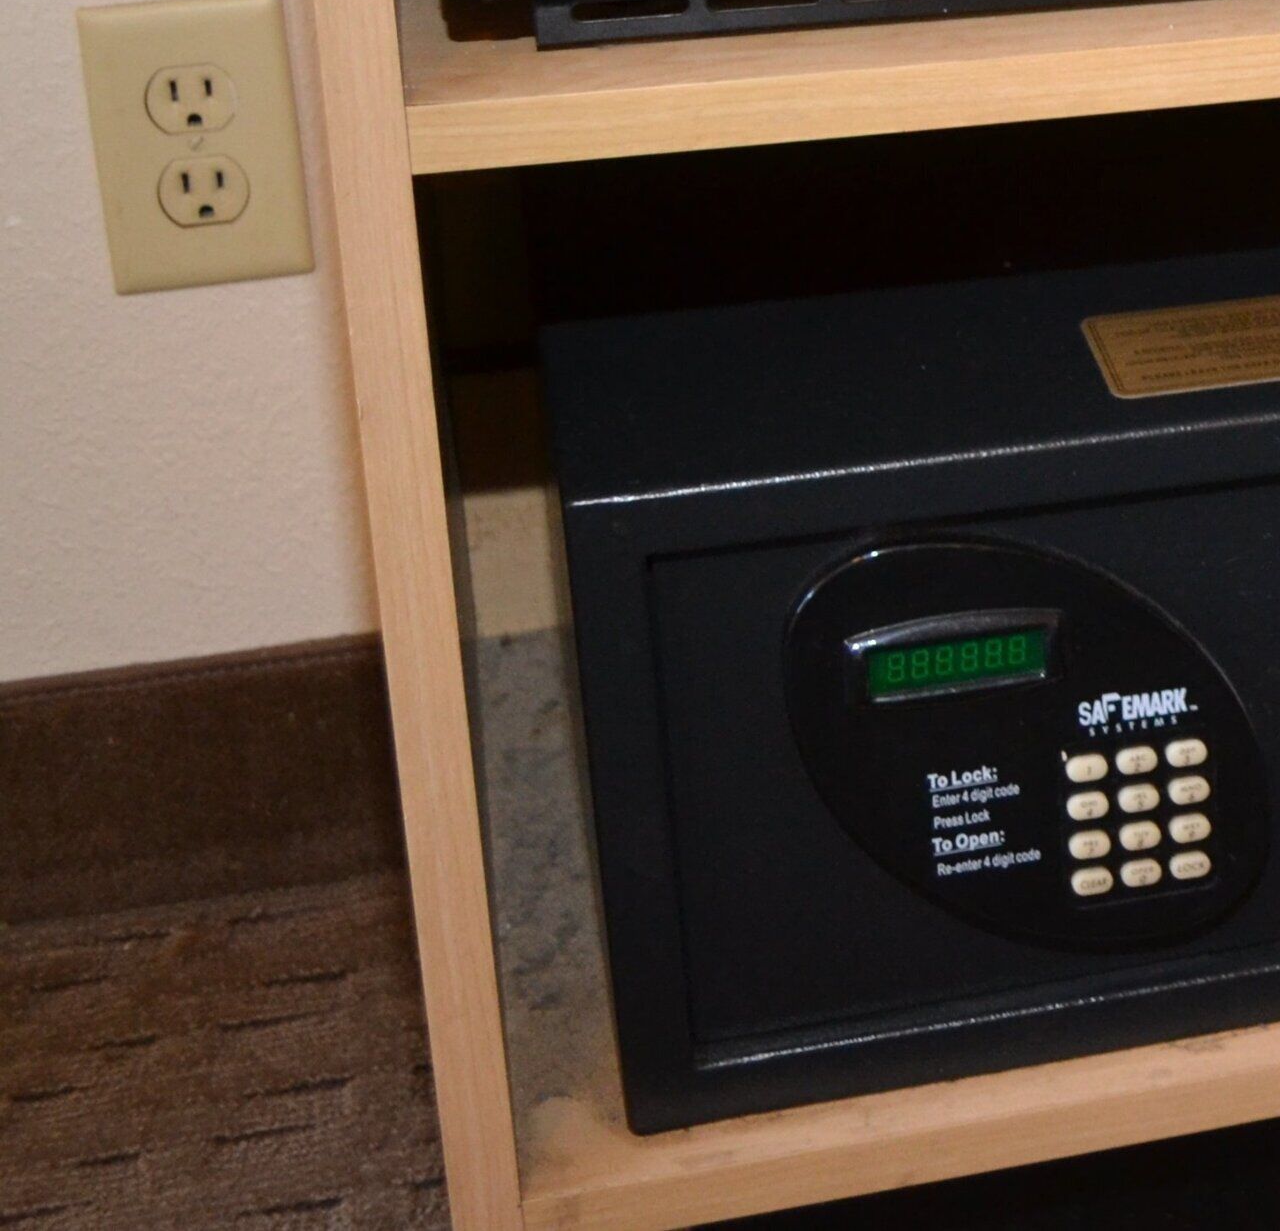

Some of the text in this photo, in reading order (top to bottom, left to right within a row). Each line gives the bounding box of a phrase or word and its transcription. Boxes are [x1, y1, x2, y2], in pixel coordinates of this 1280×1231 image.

[1078, 687, 1188, 726] SAFEMARK
[927, 765, 998, 790] To Lock:
[932, 783, 1020, 808] Enter 4 digit code
[934, 809, 990, 830] Press Lock
[932, 830, 1005, 853] To Open:
[937, 848, 1041, 876] Re-enter 4 digit code
